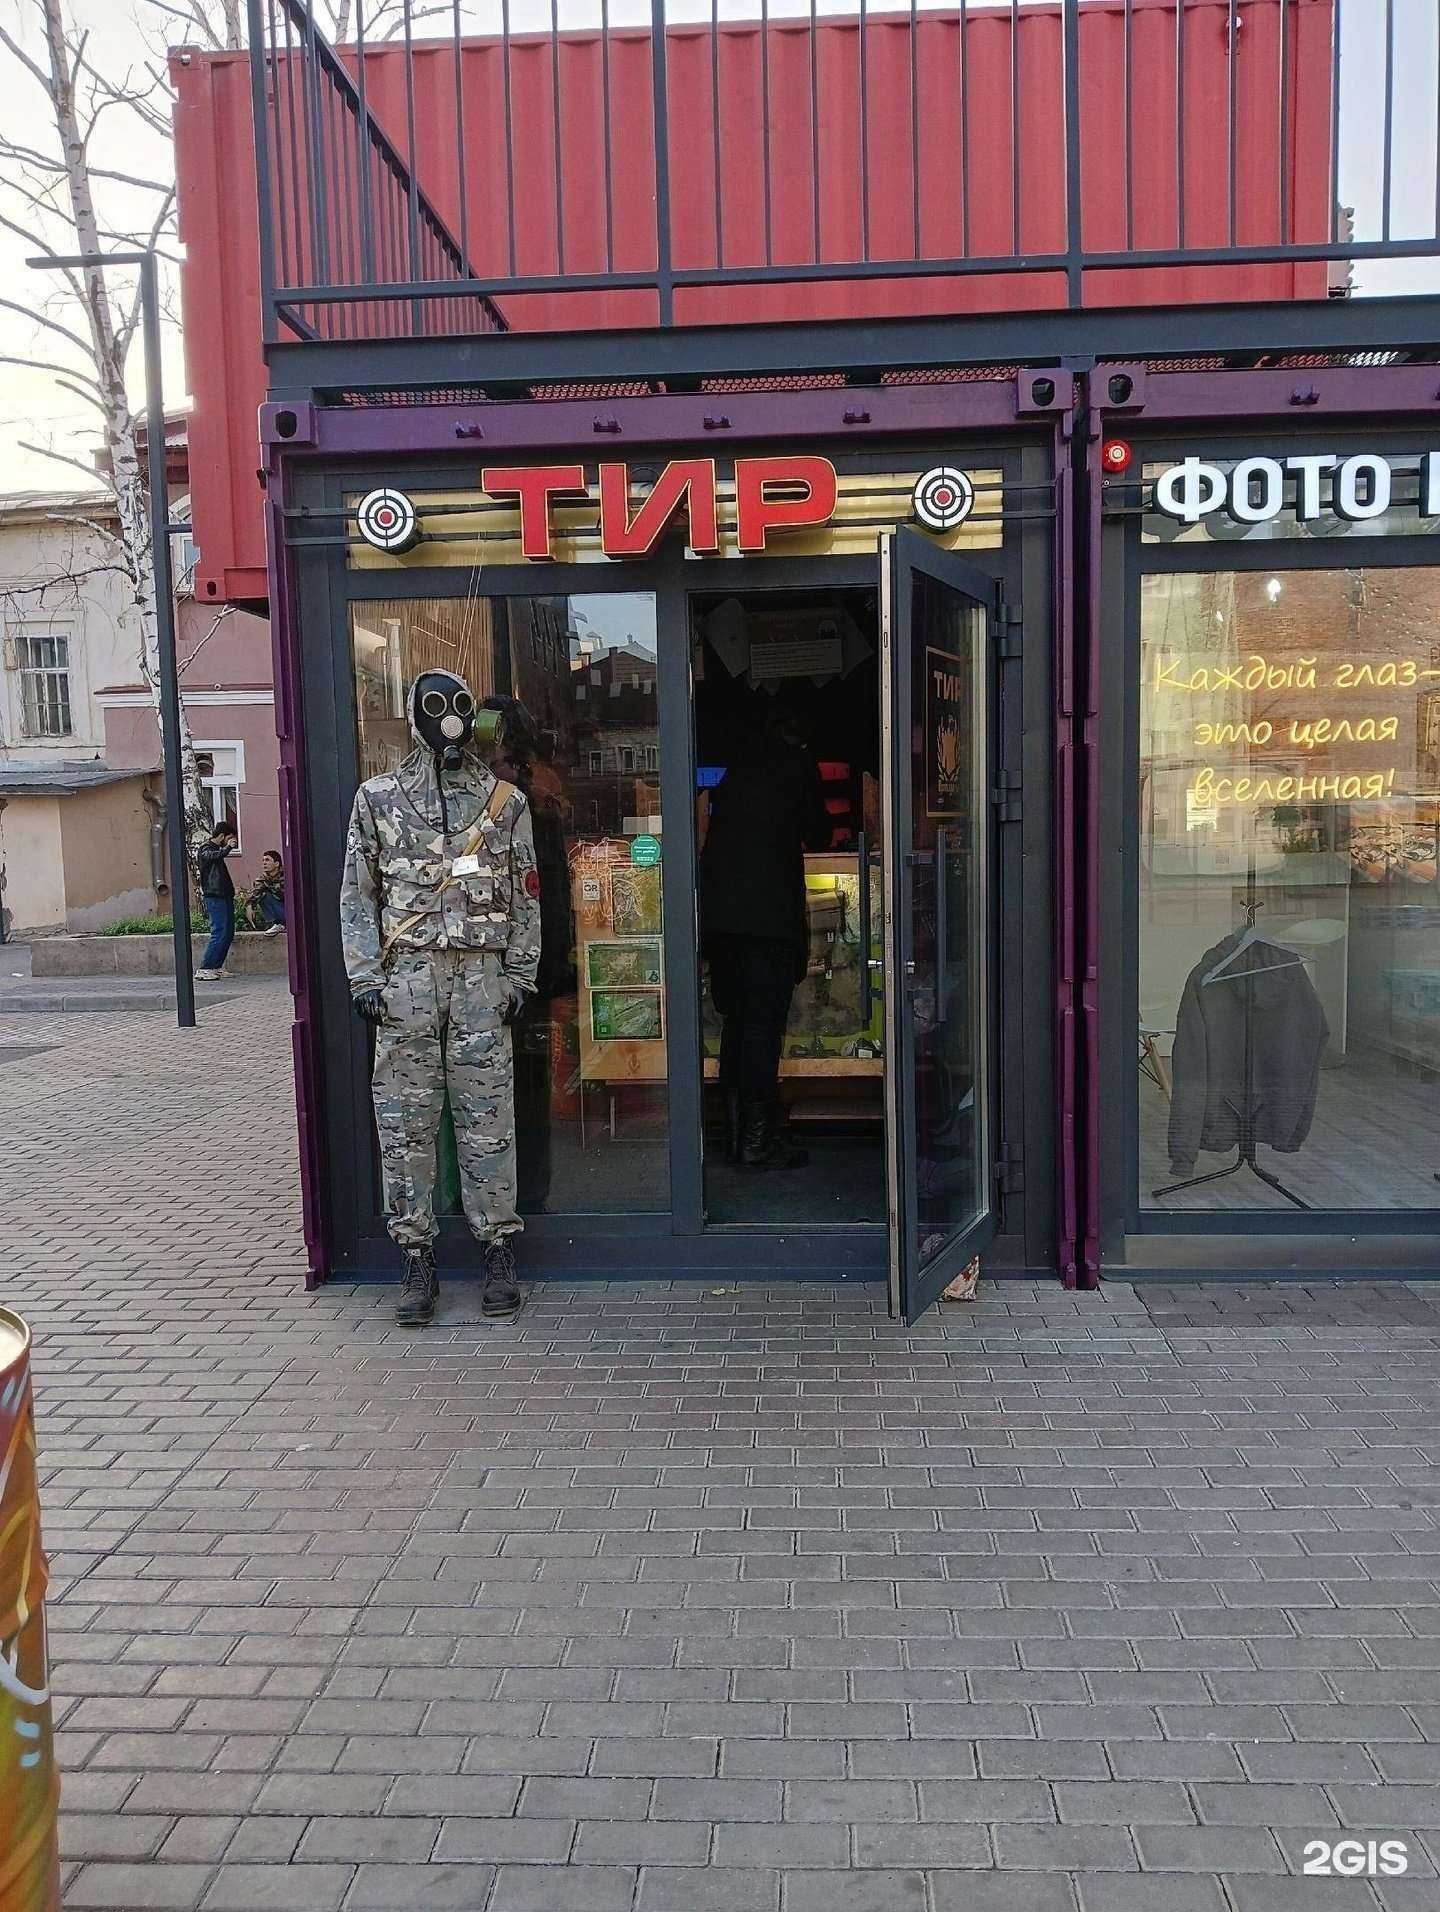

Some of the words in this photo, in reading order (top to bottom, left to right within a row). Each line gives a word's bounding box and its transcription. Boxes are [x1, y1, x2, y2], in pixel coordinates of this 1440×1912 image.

[1155, 454, 1392, 522] ФОТО
[481, 455, 838, 560] ТИР
[1154, 655, 1317, 693] Каждый
[1194, 718, 1273, 746] это
[1289, 715, 1399, 749] целая
[1193, 766, 1396, 803] вселенная!
